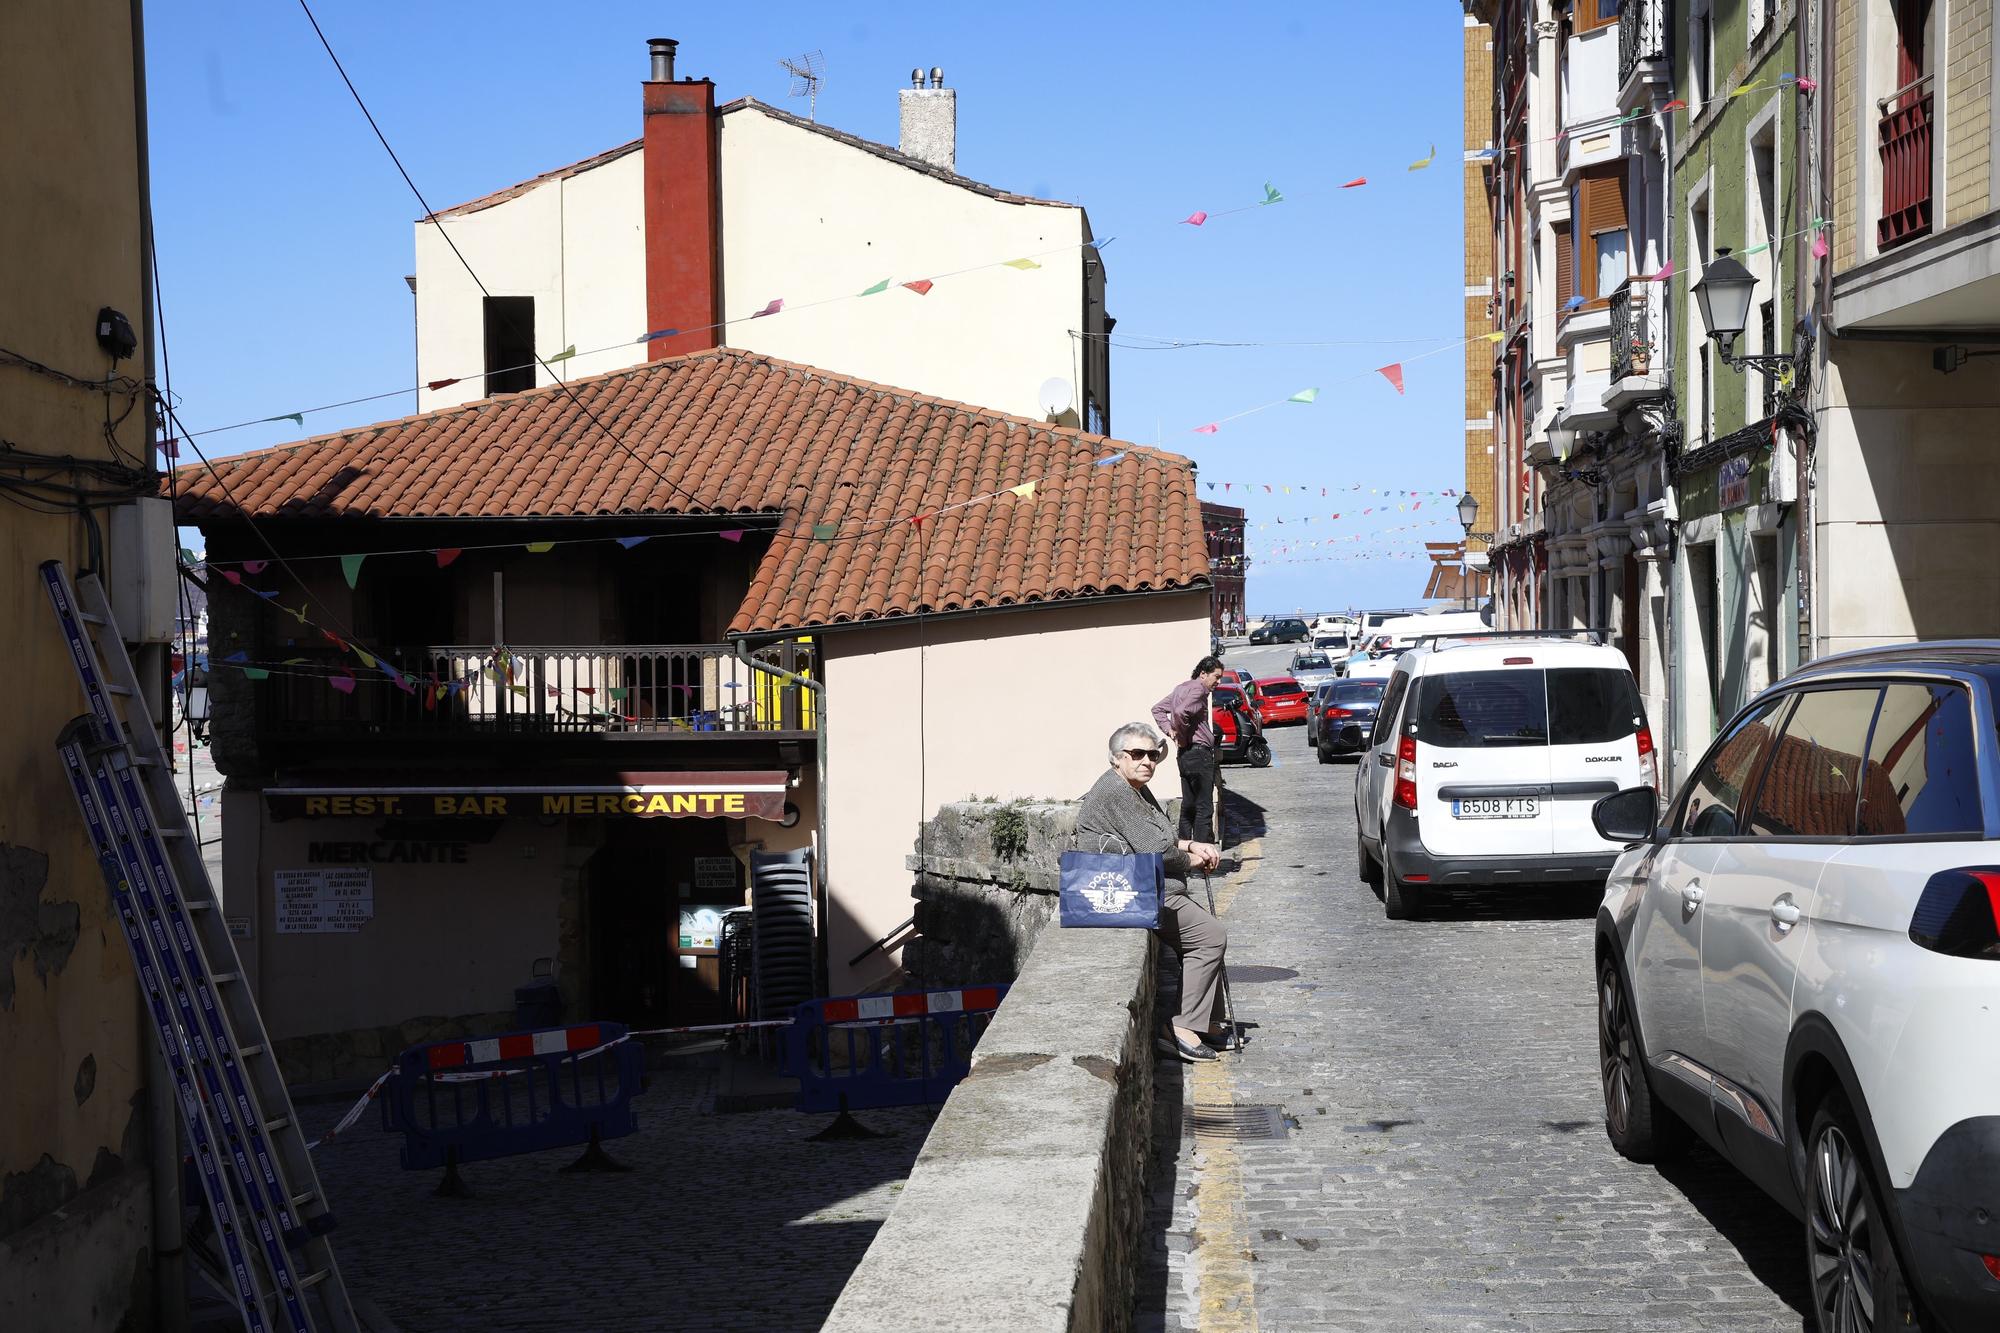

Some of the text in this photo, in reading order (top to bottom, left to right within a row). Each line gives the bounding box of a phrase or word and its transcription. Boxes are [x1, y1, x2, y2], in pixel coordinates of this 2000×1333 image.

[305, 794, 744, 817] REST. BAR MERCANTE
[1462, 798, 1535, 813] 6508 KTS
[308, 841, 467, 864] MERCANTE
[1088, 871, 1132, 891] DOCKERS
